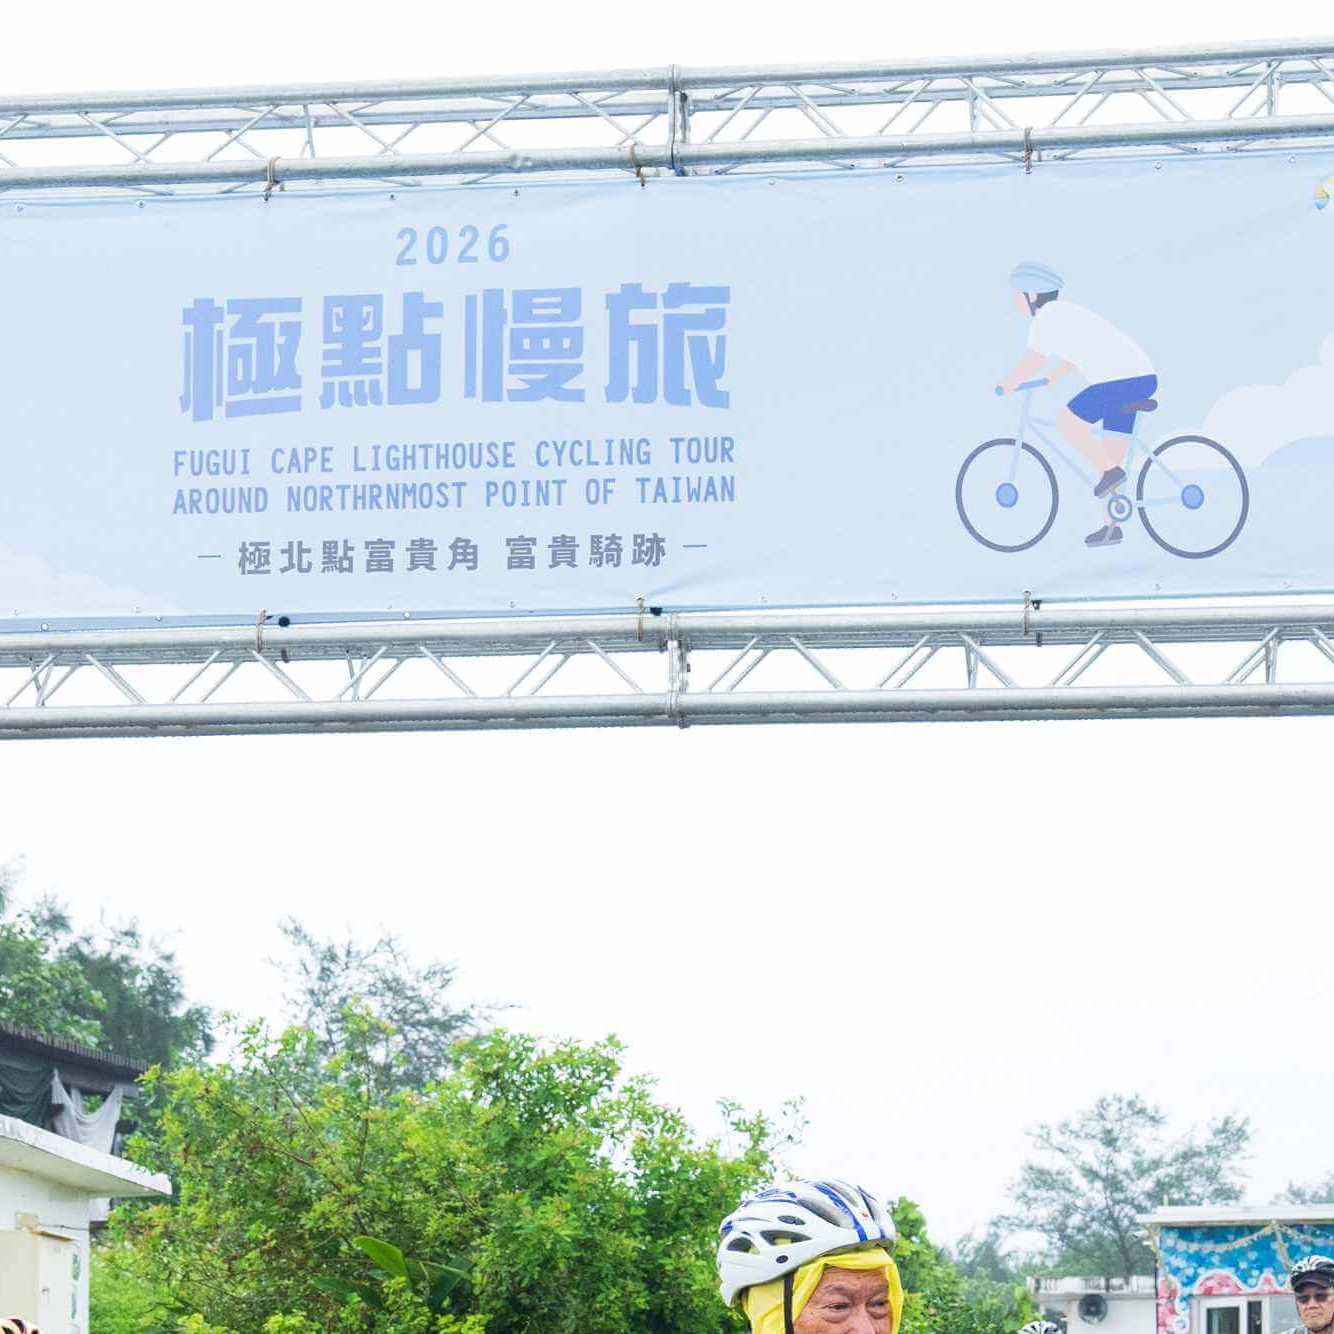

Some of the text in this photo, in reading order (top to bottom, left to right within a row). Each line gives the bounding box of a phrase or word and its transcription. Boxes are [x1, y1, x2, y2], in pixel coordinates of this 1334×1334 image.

[395, 224, 510, 266] 2026
[180, 282, 731, 422] 極點慢旅
[173, 435, 735, 477] FUGUI CAPE LIGHTHOUSE CYCLING TOUR
[172, 475, 735, 515] AROUND NORTHRNMOST POINT OF TAIWAN
[237, 532, 667, 576] 極北點富貴角 富貴騎跡
